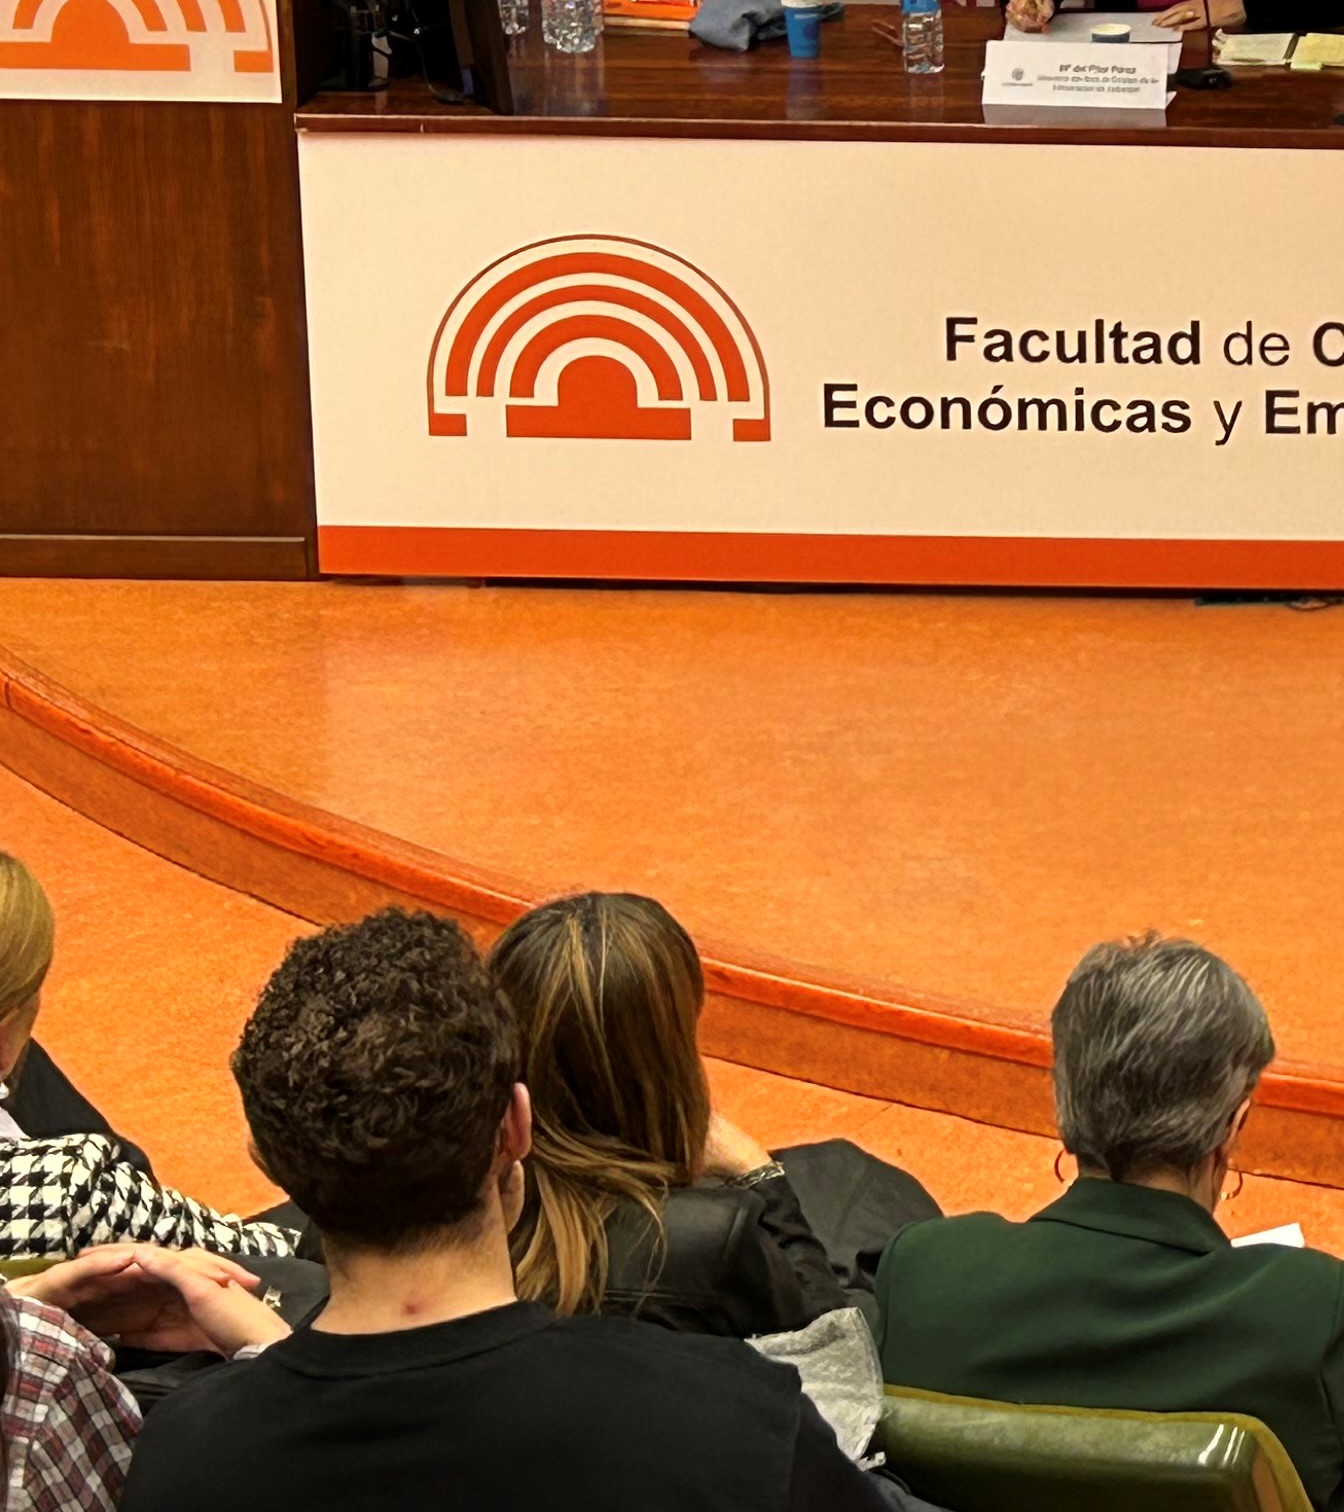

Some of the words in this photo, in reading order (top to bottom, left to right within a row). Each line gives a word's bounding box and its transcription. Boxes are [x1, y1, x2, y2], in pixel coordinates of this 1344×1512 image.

[946, 317, 1201, 365] Facultad
[1223, 321, 1290, 367] de
[823, 383, 1191, 434] Económicas
[1213, 400, 1243, 446] y
